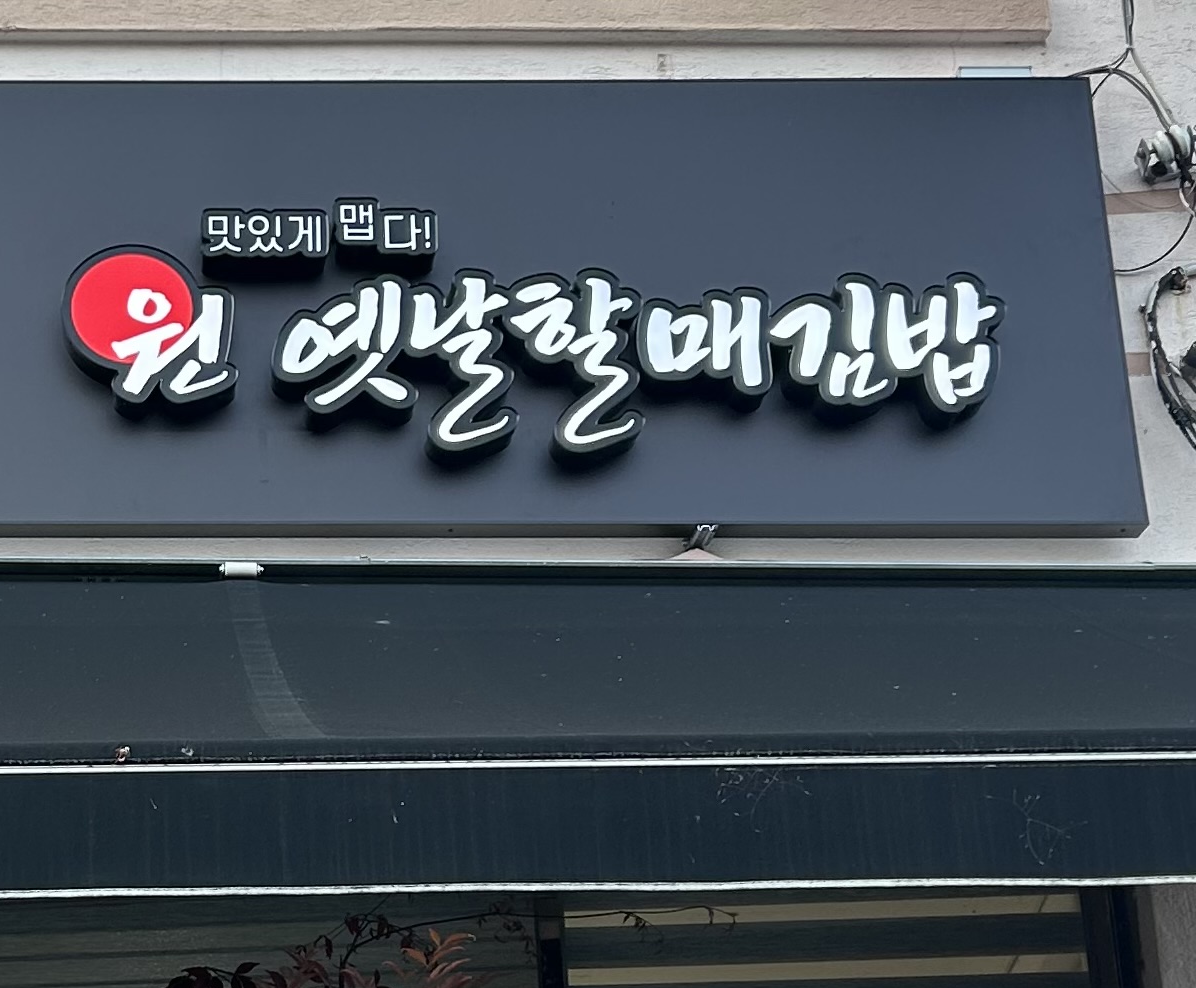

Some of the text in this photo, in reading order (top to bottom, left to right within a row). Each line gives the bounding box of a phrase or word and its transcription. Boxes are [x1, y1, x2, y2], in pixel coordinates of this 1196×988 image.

[207, 203, 432, 253] 맛있게 맵다!
[110, 287, 229, 395] 원
